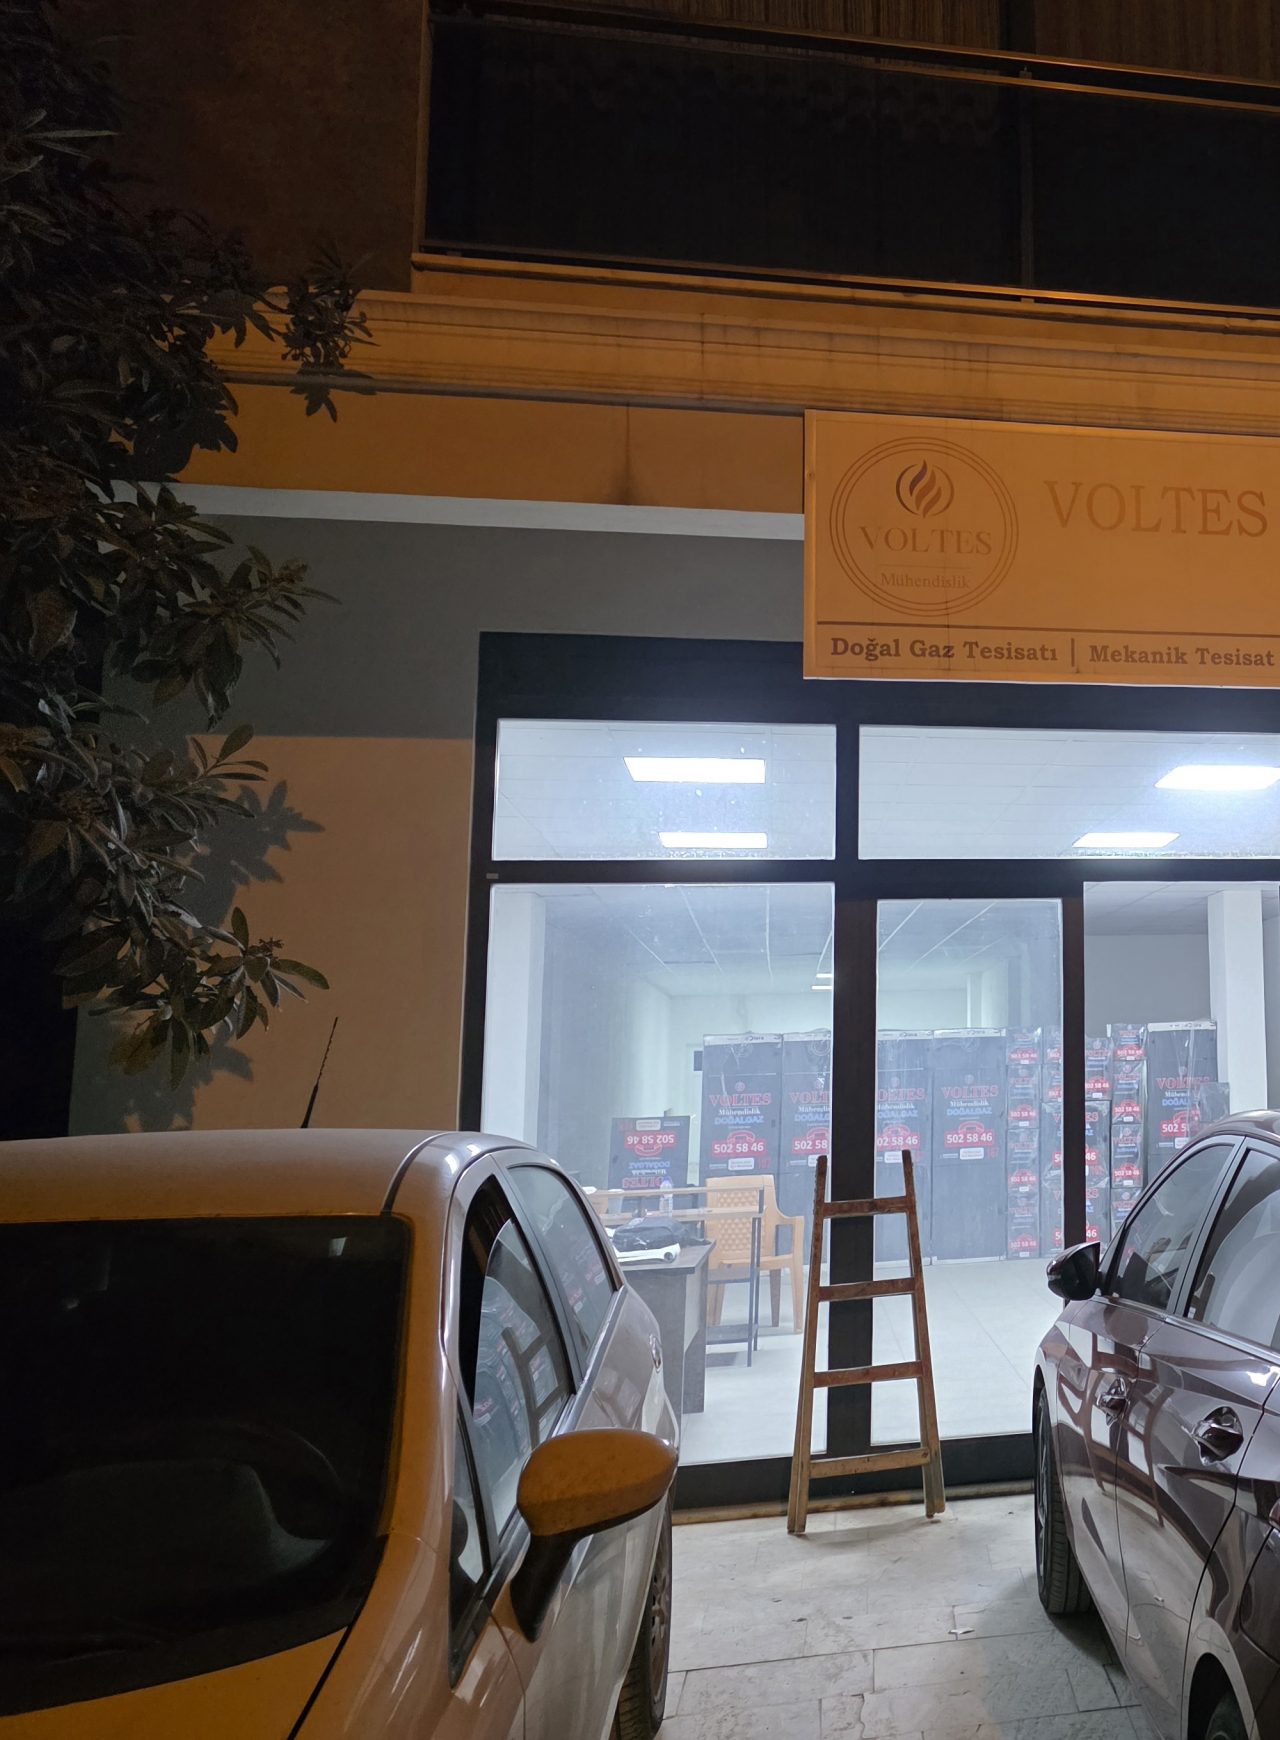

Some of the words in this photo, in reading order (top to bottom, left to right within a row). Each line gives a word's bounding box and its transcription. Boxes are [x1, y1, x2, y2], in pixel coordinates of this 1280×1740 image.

[1043, 480, 1268, 538] VOLTES
[859, 526, 992, 556] VOLTES
[880, 573, 970, 589] Mühendislik
[830, 637, 901, 662] Doğal
[909, 639, 955, 658] Gaz
[963, 640, 1058, 661] Tesisatı
[1088, 644, 1189, 665] Mekanik
[1195, 646, 1275, 667] Tesisat
[790, 1091, 829, 1105] VOLT
[878, 1087, 925, 1102] OLTES
[941, 1084, 999, 1099] VOLTES
[709, 1091, 772, 1107] VOLTES
[1162, 1124, 1179, 1133] 502
[626, 1135, 640, 1145] 46
[641, 1135, 654, 1145] 58
[656, 1134, 675, 1144] 502
[794, 1140, 813, 1150] 502
[815, 1140, 828, 1149] 58
[877, 1137, 889, 1146] 02
[891, 1137, 904, 1146] 58
[905, 1136, 918, 1145] 46
[946, 1134, 964, 1144] 502
[966, 1133, 979, 1143] 58
[980, 1132, 993, 1142] 46
[714, 1144, 734, 1153] 502
[736, 1143, 749, 1152] 58
[751, 1142, 764, 1151] 46
